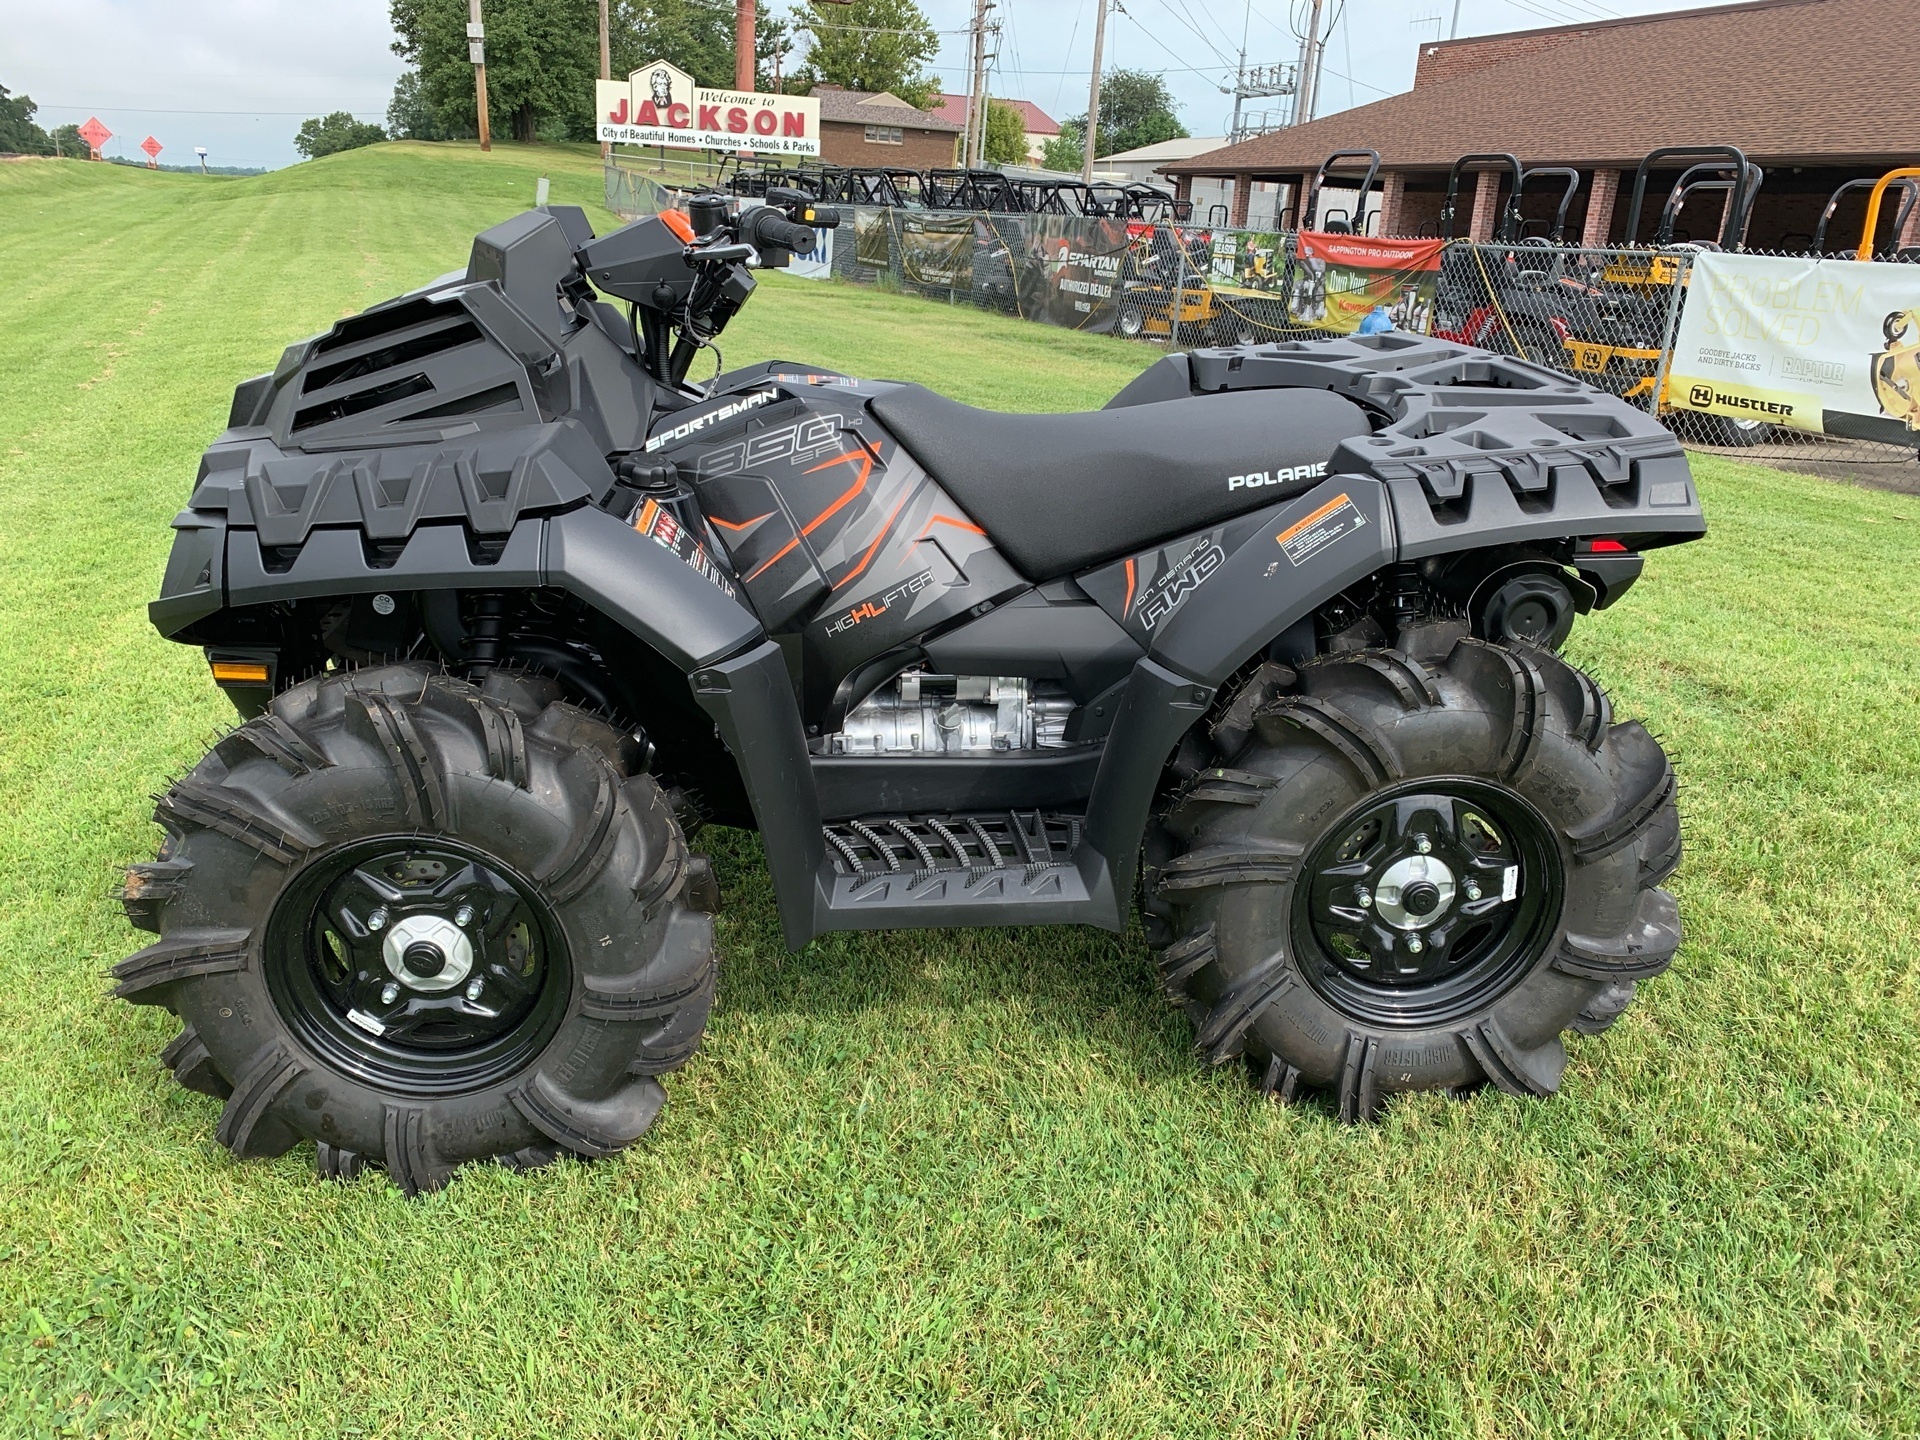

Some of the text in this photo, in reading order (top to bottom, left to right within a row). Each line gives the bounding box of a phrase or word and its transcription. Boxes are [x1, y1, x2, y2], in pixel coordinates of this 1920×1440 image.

[700, 91, 775, 107] Welcome to
[609, 98, 805, 138] JACKSON
[602, 127, 815, 153] City of Beautiful Homes Churches Schools & Parks
[1214, 243, 1237, 255] REASON
[1328, 244, 1415, 260] SAPPINGTON PRO OUTDOOR
[1068, 252, 1120, 271] SPARTAN
[1212, 257, 1235, 277] OWN
[1094, 270, 1118, 279] MOWERS
[1329, 270, 1348, 292] Own
[1349, 272, 1367, 296] Your
[1060, 279, 1112, 299] AUTHORIZED DEALER
[1710, 274, 1865, 316] PROBLEM
[1703, 306, 1821, 346] SOLVED
[1698, 356, 1762, 371] AND DIRTY BACKS
[1699, 347, 1757, 362] GOODBYE JACKS
[1782, 356, 1846, 381] RAPTOR
[1799, 377, 1824, 385] FLIP-UP
[1715, 393, 1794, 417] HUSTLER
[645, 387, 778, 453] SPORTSMAN
[695, 413, 844, 485] 850
[1228, 461, 1329, 491] POLARIS
[1301, 505, 1332, 527] WARNING
[1138, 544, 1226, 631] AWD
[1383, 1048, 1423, 1067] LIFTER
